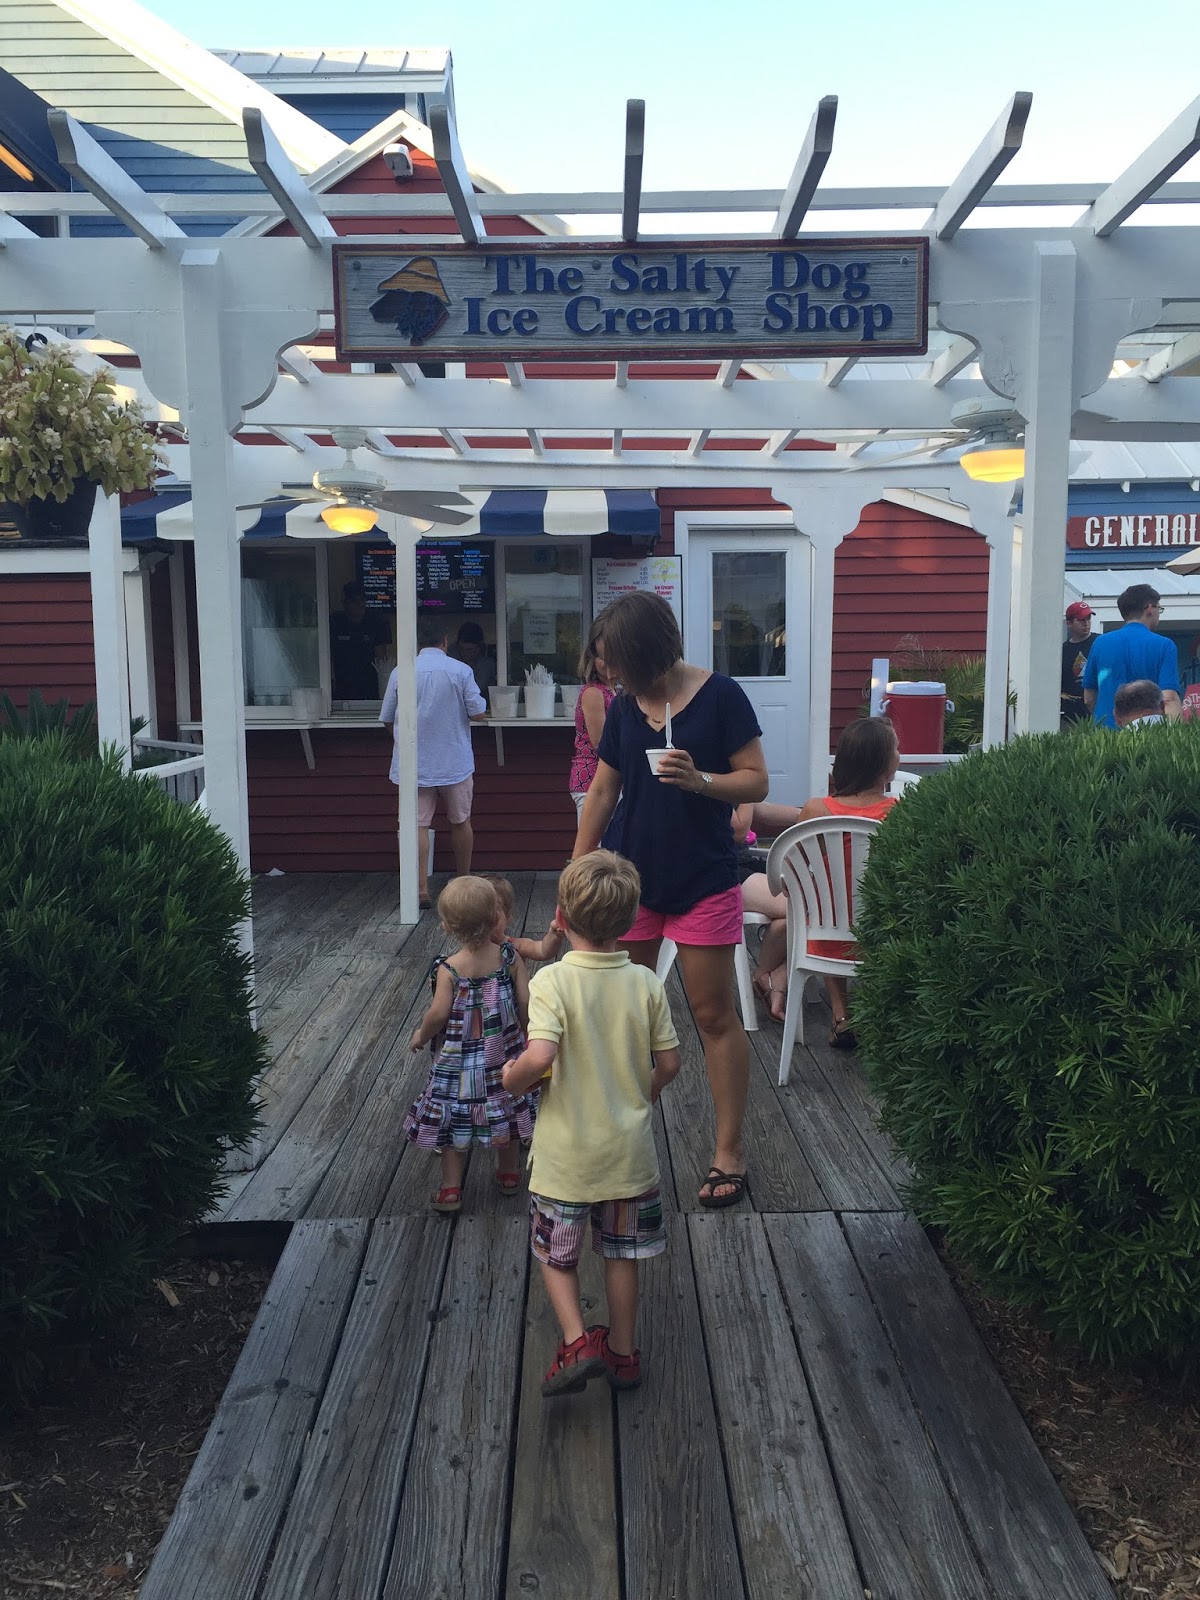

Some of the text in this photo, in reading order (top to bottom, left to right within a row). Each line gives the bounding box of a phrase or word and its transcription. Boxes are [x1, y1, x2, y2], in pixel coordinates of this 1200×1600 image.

[484, 251, 871, 301] The Salty Dog
[462, 291, 893, 341] Ice Cream Shop
[1084, 514, 1200, 547] GENERAL
[449, 578, 476, 591] OPEN
